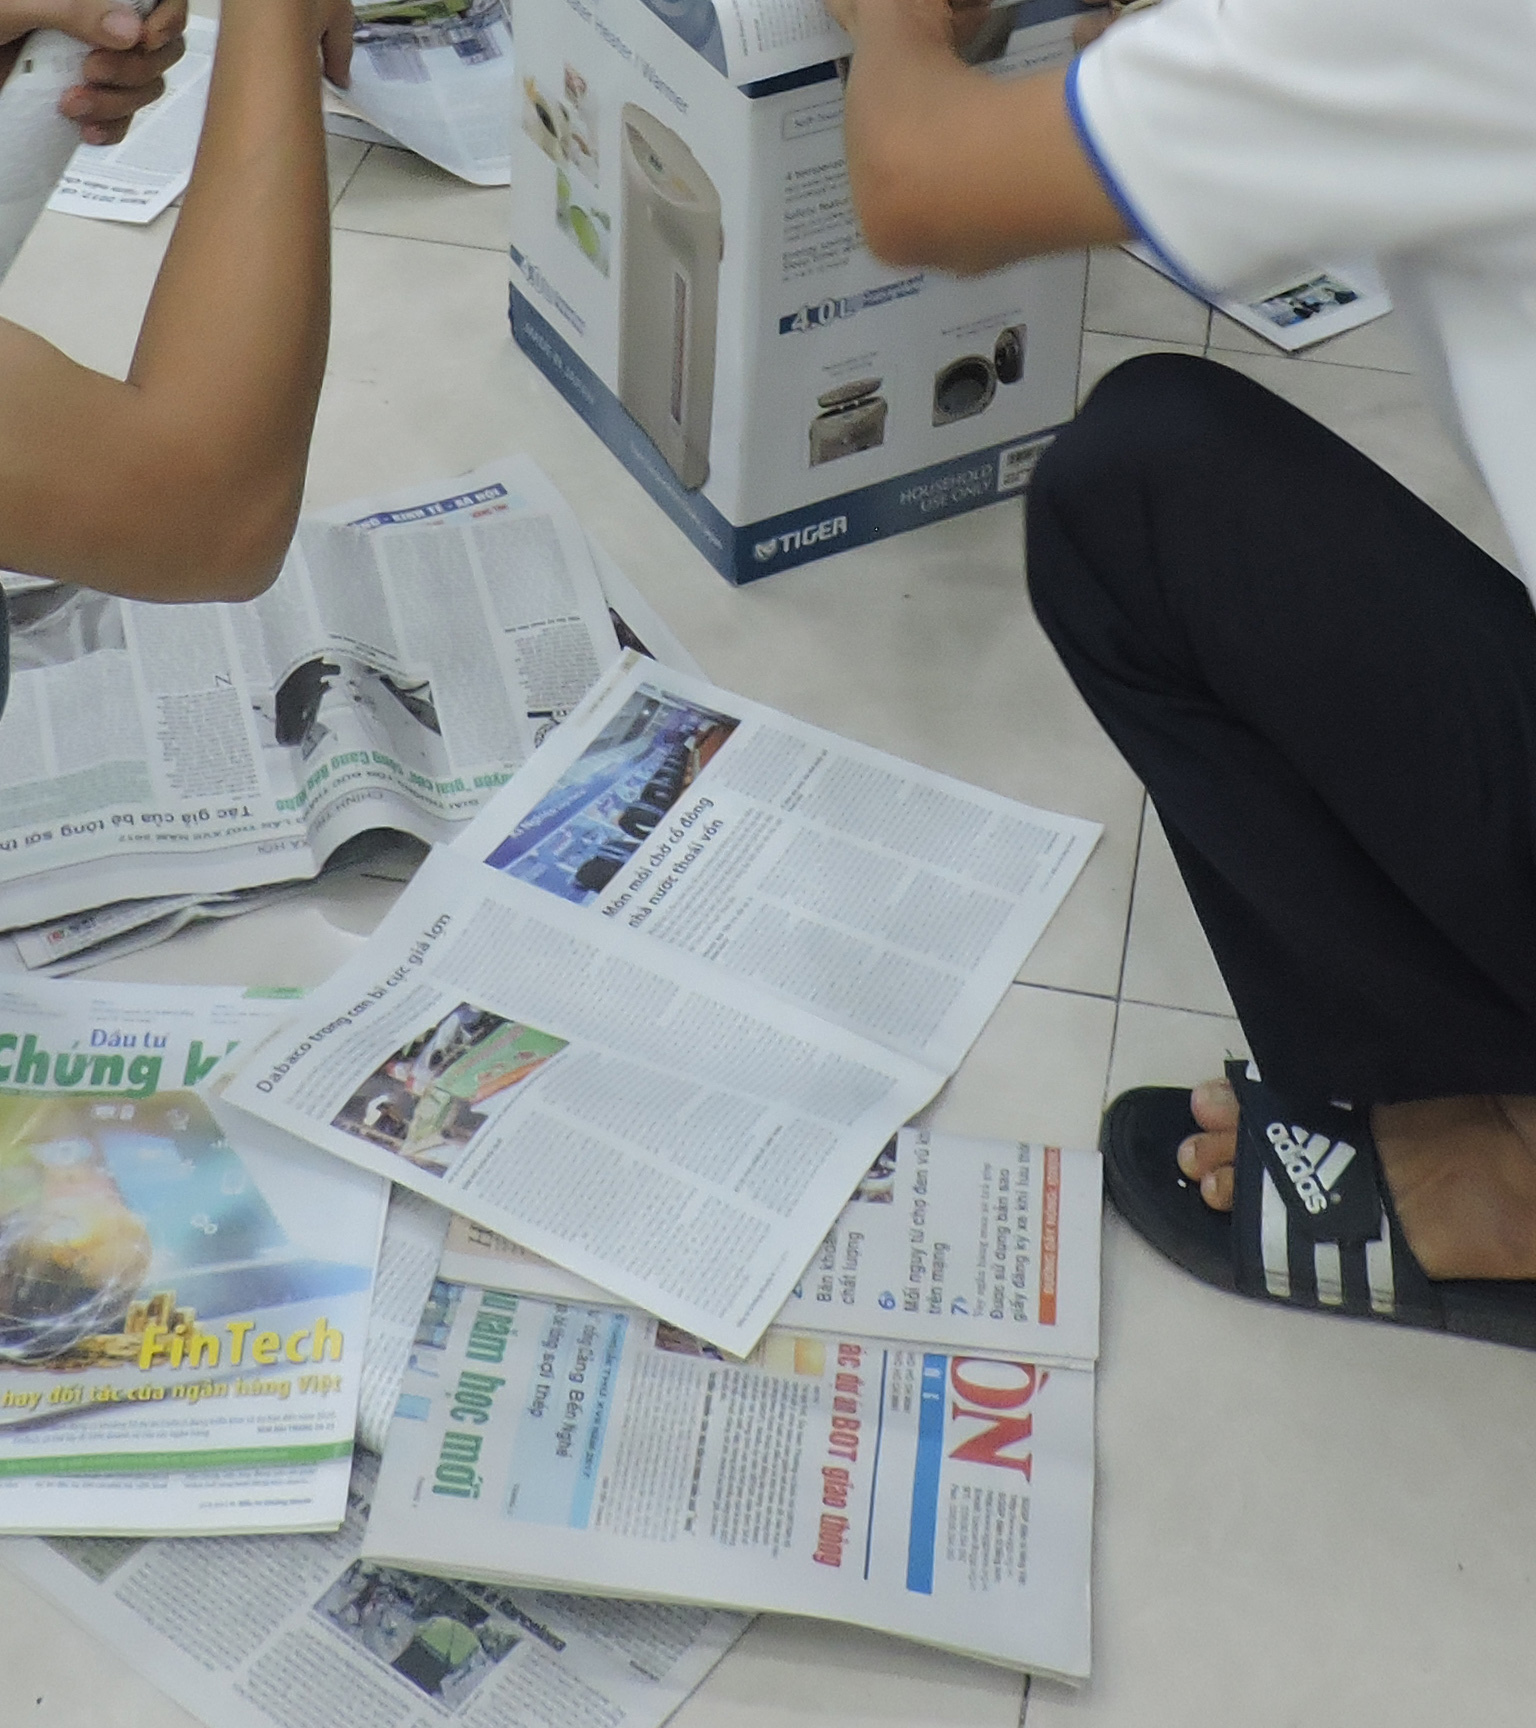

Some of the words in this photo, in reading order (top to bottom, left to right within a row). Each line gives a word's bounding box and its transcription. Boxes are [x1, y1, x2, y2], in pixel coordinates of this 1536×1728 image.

[780, 516, 848, 553] TIGER
[257, 1040, 313, 1093] Dabaco
[1266, 1122, 1327, 1214] adidas
[878, 1295, 896, 1311] 6
[951, 1301, 969, 1315] 7
[137, 1317, 344, 1371] FinTech
[447, 1371, 505, 1424] học
[950, 1357, 1050, 1484] ÒN
[433, 1431, 484, 1499] mới
[829, 1416, 860, 1461] BOT
